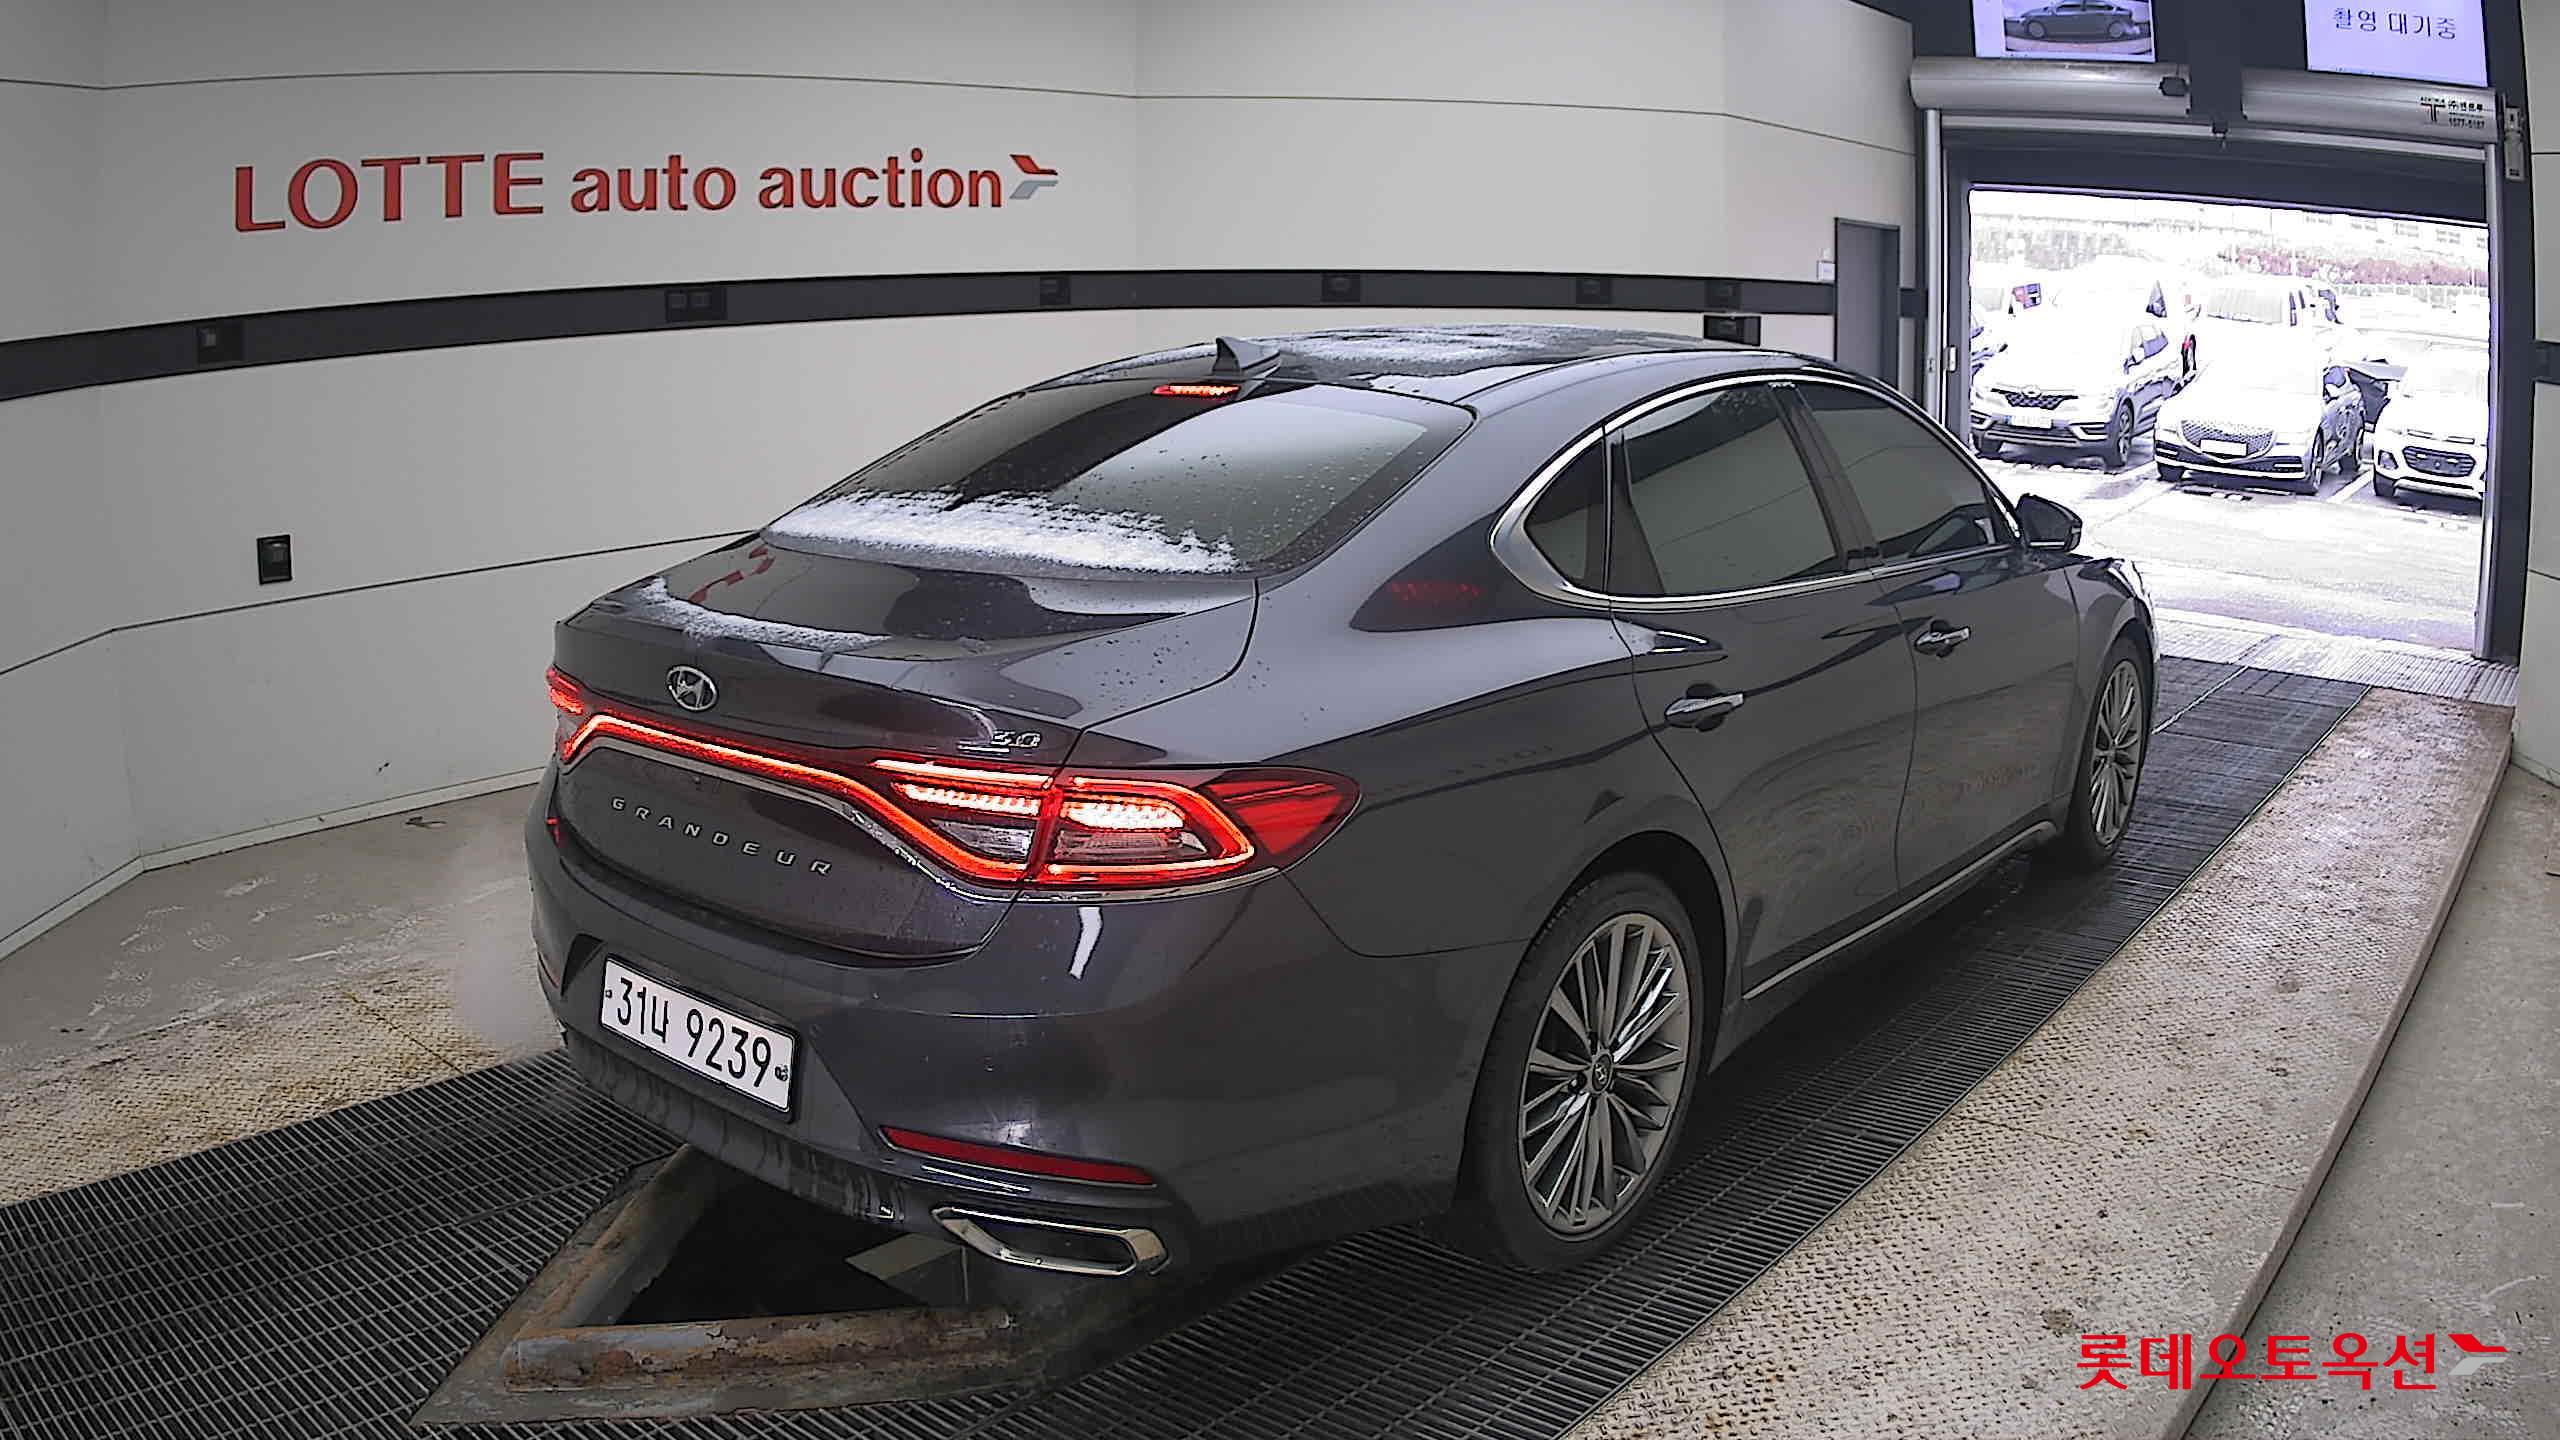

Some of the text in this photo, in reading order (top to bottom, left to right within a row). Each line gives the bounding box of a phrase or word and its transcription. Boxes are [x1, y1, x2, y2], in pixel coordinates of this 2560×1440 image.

[2387, 12, 2456, 40] 대기중
[234, 148, 1004, 233] LOTTE auto auction
[611, 798, 832, 876] GRANDEUR
[686, 1008, 772, 1088] 9239
